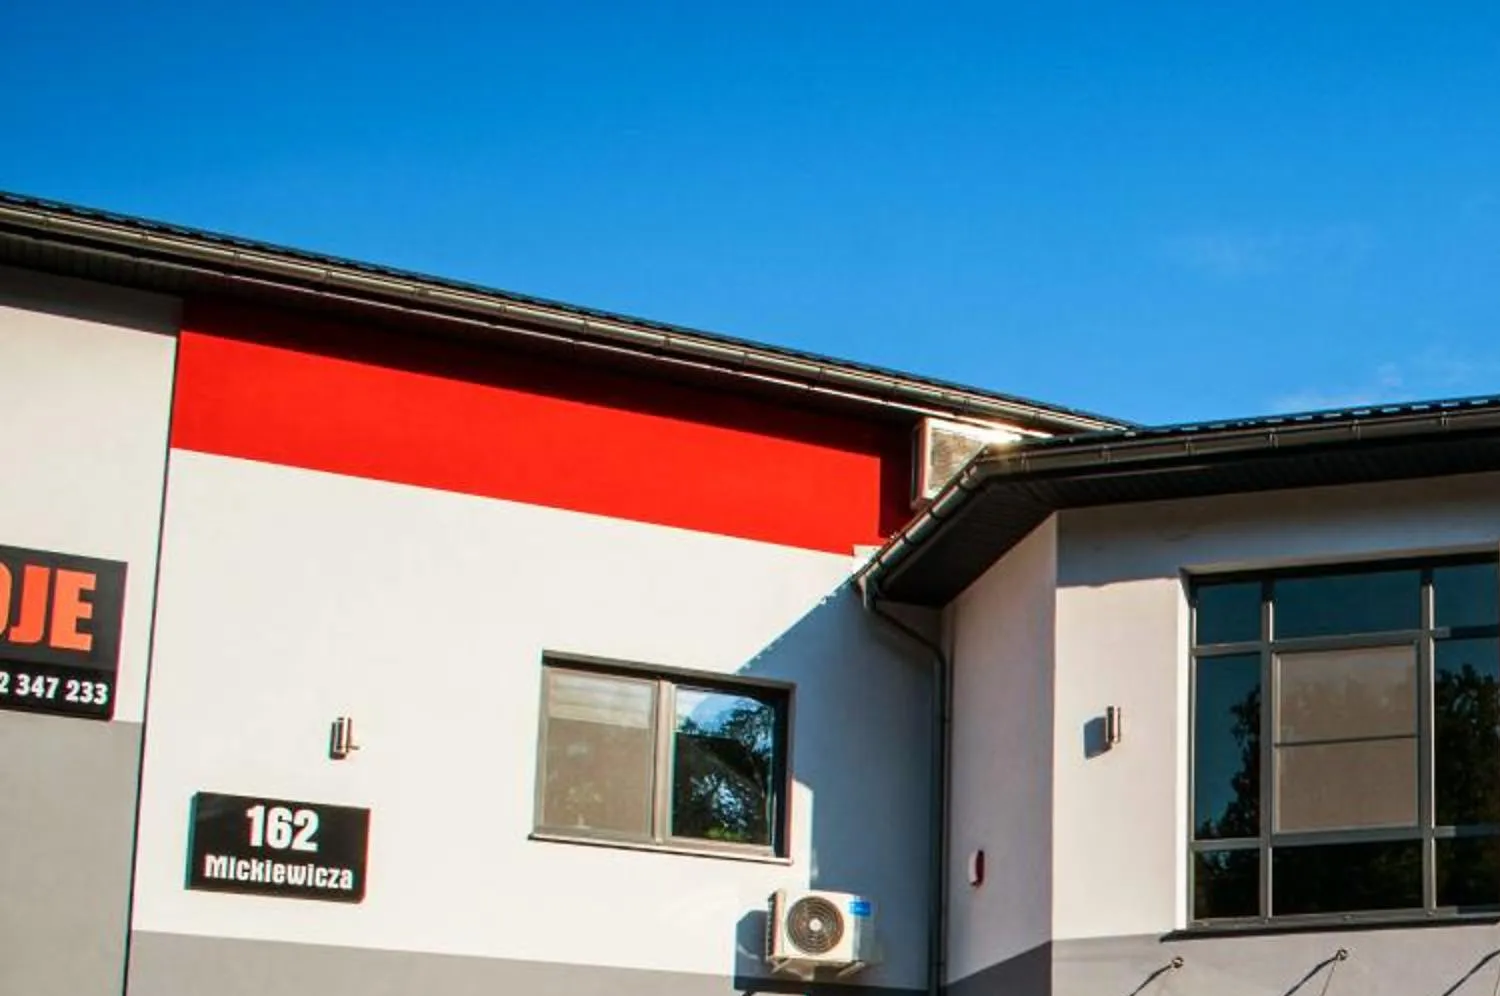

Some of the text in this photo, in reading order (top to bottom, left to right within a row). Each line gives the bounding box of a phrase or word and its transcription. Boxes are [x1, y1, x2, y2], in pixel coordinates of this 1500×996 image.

[16, 673, 60, 699] 347
[65, 679, 109, 705] 233
[246, 805, 319, 852] 162
[204, 854, 354, 890] Mickiewicza
